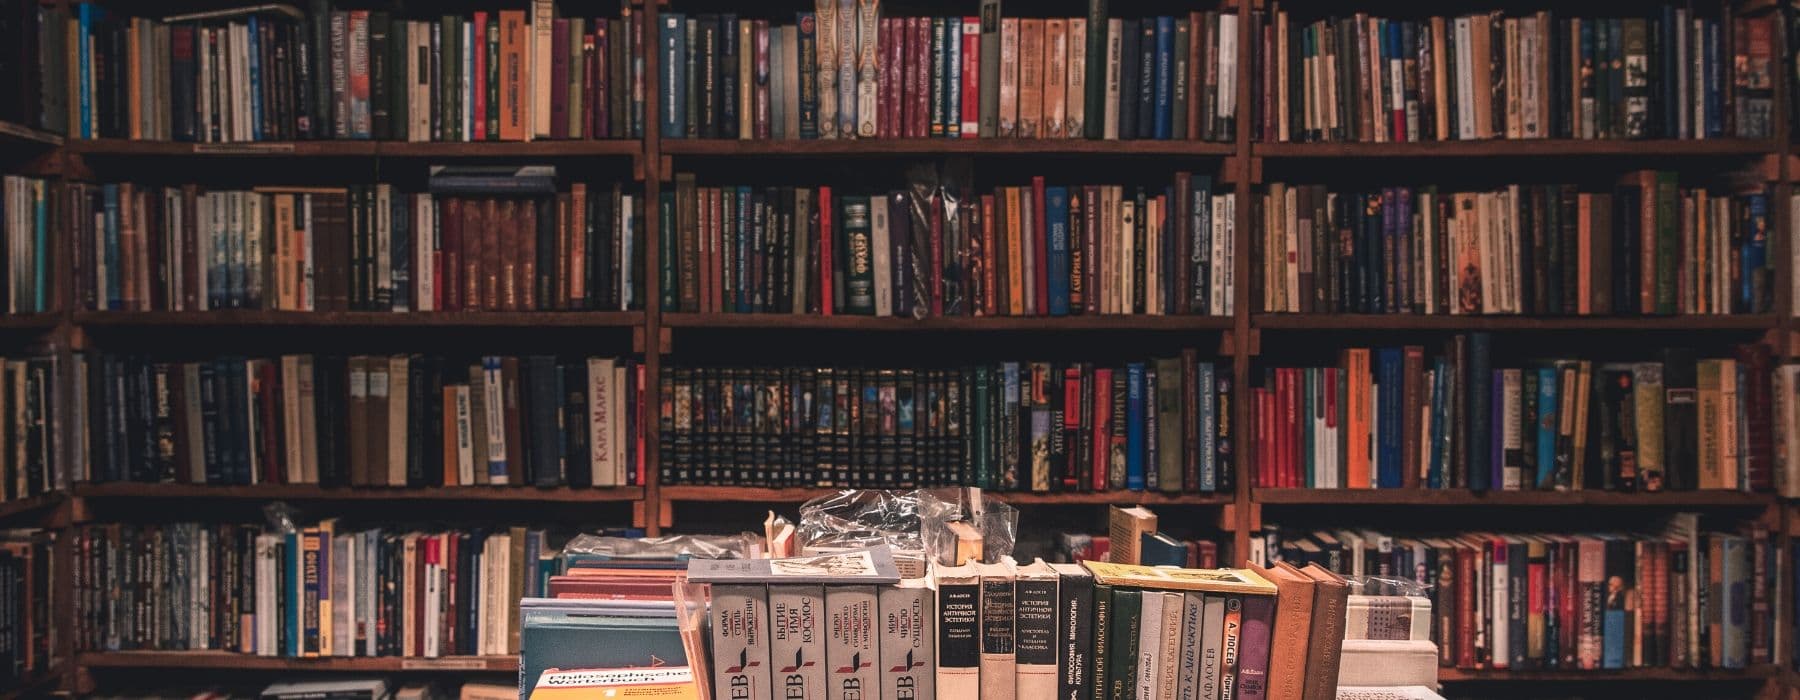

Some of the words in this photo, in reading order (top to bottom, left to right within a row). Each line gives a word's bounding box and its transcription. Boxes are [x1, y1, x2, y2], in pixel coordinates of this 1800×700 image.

[1073, 251, 1081, 292] АМЕРИКА
[593, 376, 607, 423] МАРКС
[1055, 410, 1064, 454] АНГЛИИ
[734, 609, 742, 636] СТИЛЬ
[746, 597, 755, 646] ВЫРАЖЕНИЕ
[777, 602, 785, 641] БЫТИЕ
[790, 608, 798, 634] ИМЯ
[802, 597, 811, 644] КОСМОС
[900, 609, 908, 638] ЧИСЛО
[913, 598, 921, 648] СУЩНОСТЬ
[1096, 600, 1106, 655] ФИЛОСОФИИ
[1167, 609, 1178, 663] КАТЕГОРИЙ
[1075, 654, 1083, 685] КУЛЬТУРА
[1225, 634, 1236, 665] ЛОСЕВ
[550, 671, 692, 681] Philosophische
[1095, 656, 1104, 700] НТИЧНОЙ
